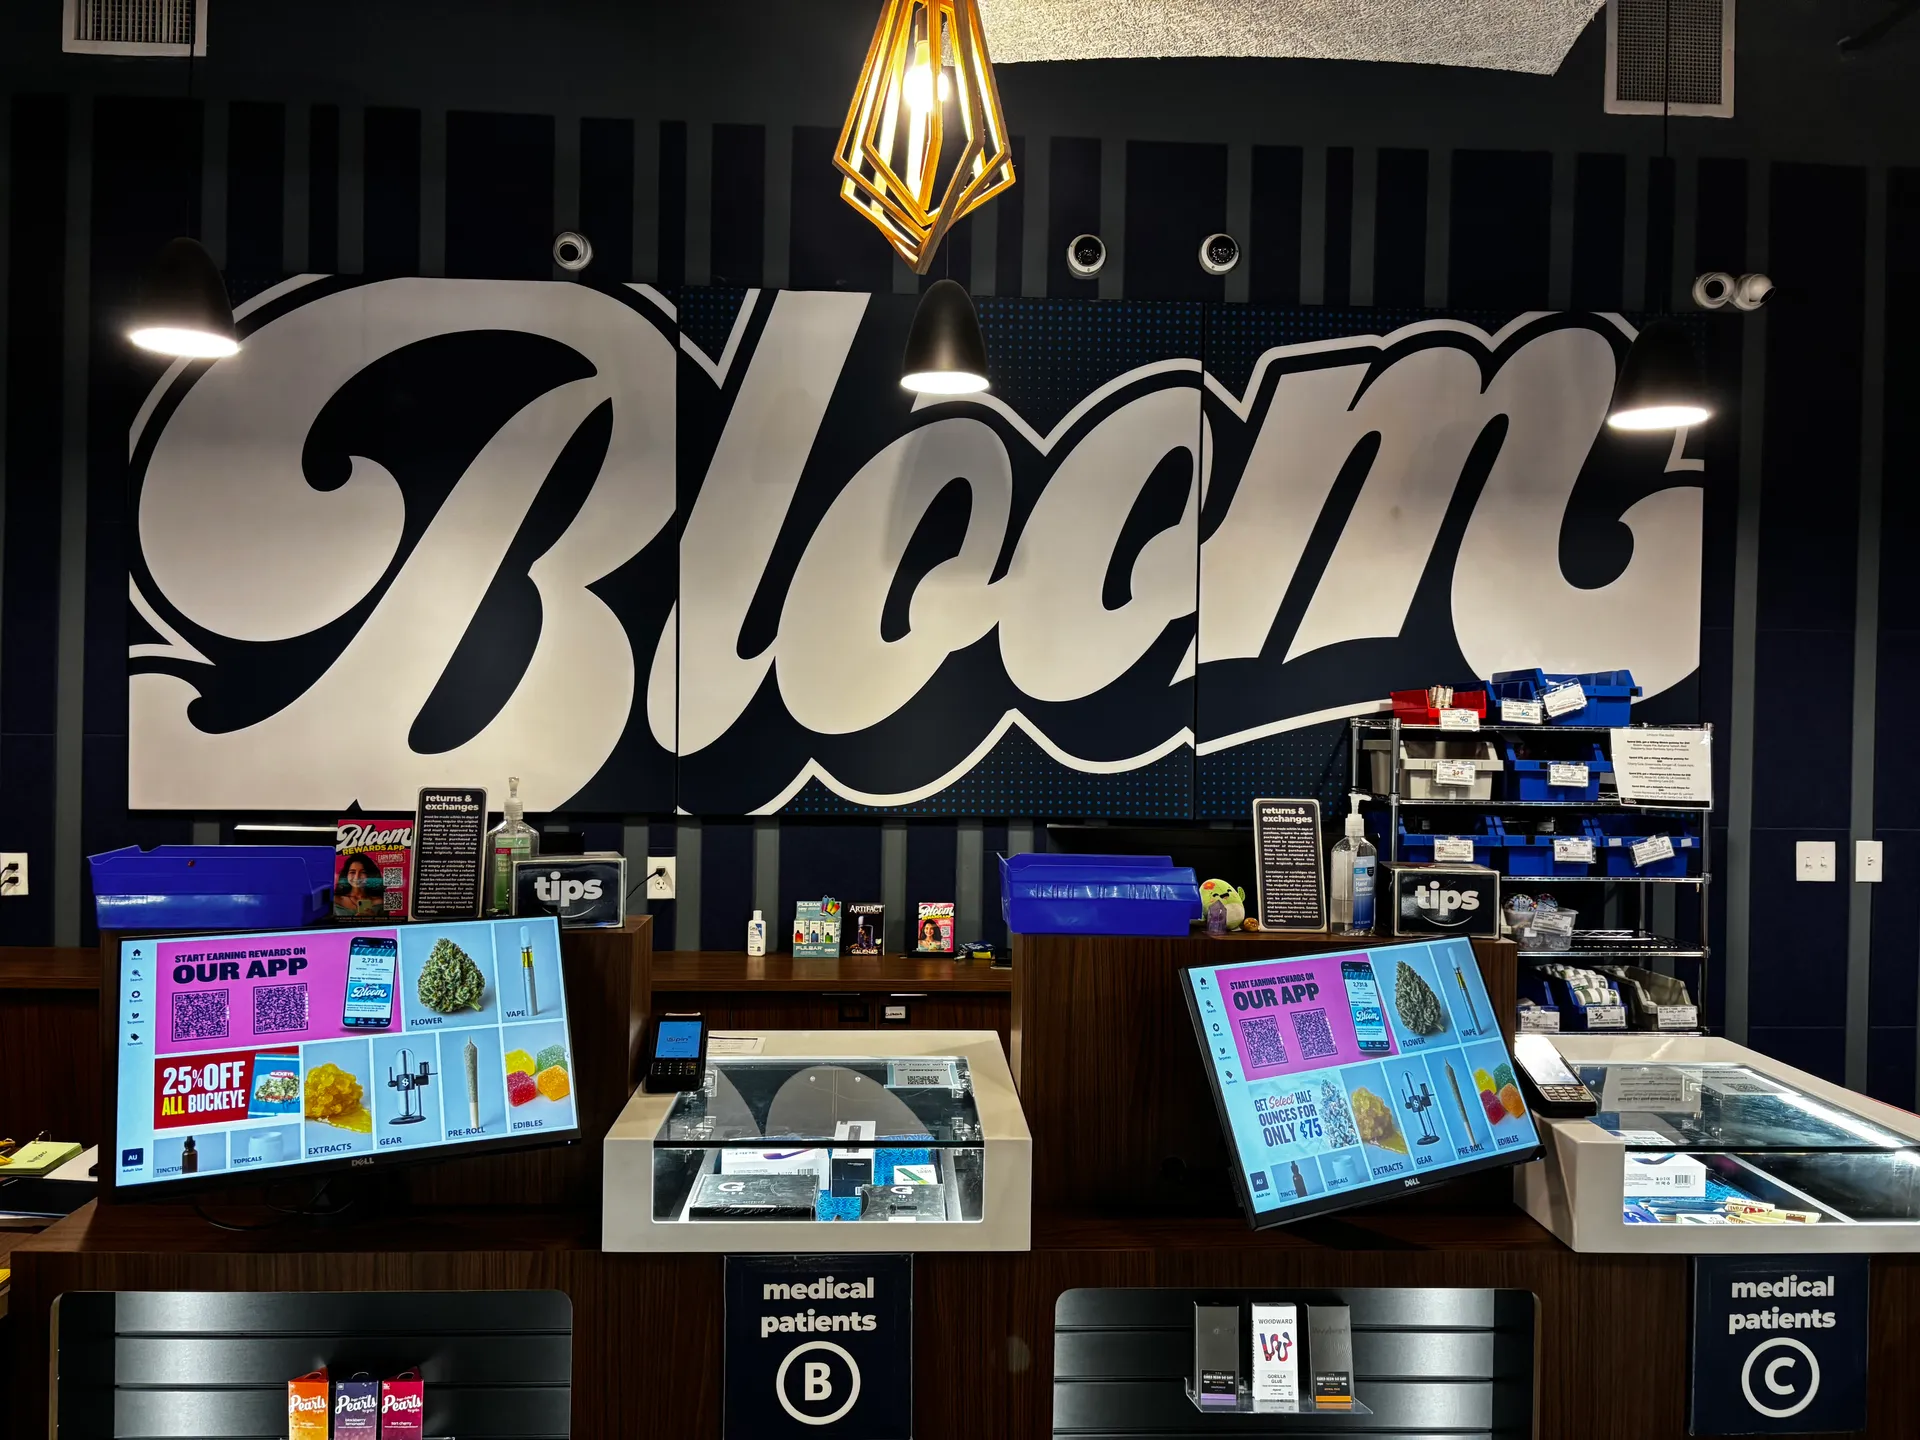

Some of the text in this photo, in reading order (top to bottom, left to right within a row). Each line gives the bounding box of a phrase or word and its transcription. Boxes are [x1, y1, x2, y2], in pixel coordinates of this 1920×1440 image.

[129, 274, 1704, 812] Bloom
[425, 802, 479, 812] exchanges
[1262, 815, 1312, 824] exchanges
[336, 824, 411, 852] Bloom
[342, 845, 386, 855] REWARDS
[534, 871, 603, 907] tips
[1415, 880, 1480, 916] tips
[849, 905, 883, 913] ARTIFACT
[918, 904, 954, 918] Bloom
[175, 947, 306, 963] START EARNING REWARDS ON
[173, 958, 308, 984] OUR APP
[1230, 980, 1250, 990] START
[1250, 978, 1277, 988] EARNING
[1277, 974, 1305, 984] REWARDS
[350, 986, 387, 997] Bloom
[1233, 983, 1320, 1011] OUR APP
[411, 1017, 442, 1026] FLOWER
[1356, 1010, 1379, 1021] Bloom
[1462, 1028, 1476, 1037] VAPE
[1402, 1037, 1425, 1048] FLOWER
[162, 1089, 245, 1116] ALL BUCKEYE
[1255, 1090, 1312, 1112] GET Select HALF
[1259, 1104, 1317, 1126] OUNCES FOR
[513, 1119, 543, 1130] EDIBLES
[448, 1127, 485, 1137] PRE-ROLL
[1263, 1118, 1322, 1147] ONLY $75
[379, 1136, 402, 1145] GEAR
[1498, 1135, 1519, 1146] EDIBLES
[308, 1143, 352, 1155] EXTRACTS
[1458, 1143, 1484, 1155] PRE-ROLL
[234, 1156, 262, 1164] TOPICALS
[351, 1158, 374, 1167] DELL
[1417, 1155, 1433, 1165] GEAR
[1373, 1162, 1404, 1176] EXTRACTS
[1328, 1177, 1348, 1186] TOPICALS
[1405, 1178, 1420, 1187] DELL
[764, 1275, 874, 1300] medical
[1732, 1275, 1834, 1298] medical
[761, 1309, 877, 1338] patients
[1729, 1306, 1836, 1334] patients
[804, 1363, 832, 1401] B
[1764, 1357, 1796, 1395] C
[289, 1394, 326, 1413] Pearls
[335, 1395, 378, 1414] Pearls
[382, 1395, 422, 1413] Pearls
